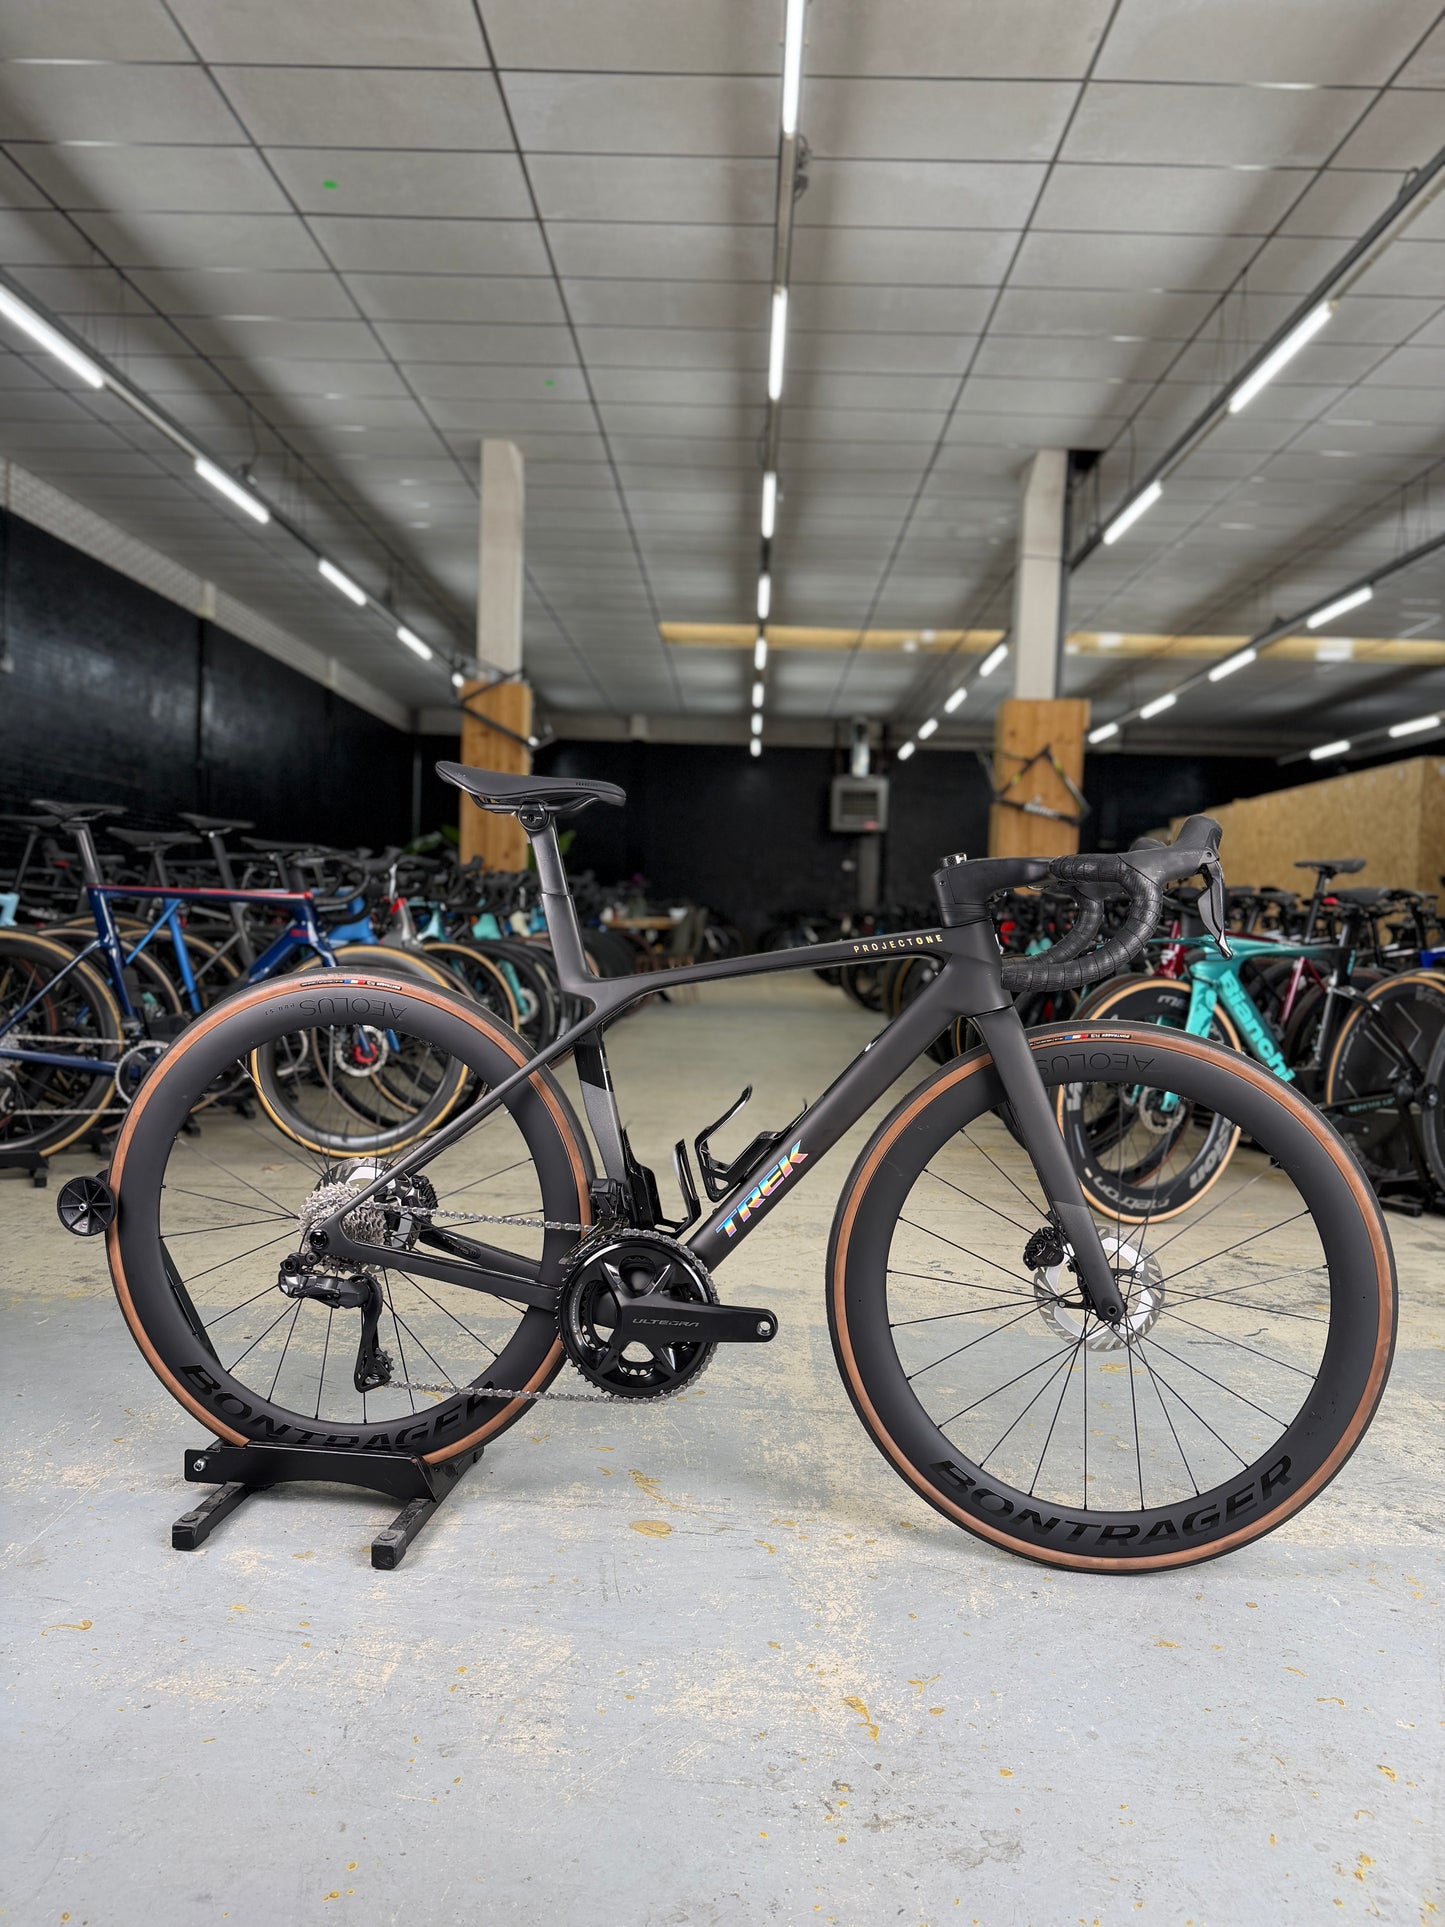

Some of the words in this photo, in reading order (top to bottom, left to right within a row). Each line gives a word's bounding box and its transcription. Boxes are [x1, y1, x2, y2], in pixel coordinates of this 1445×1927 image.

[300, 997, 408, 1020] AEOLUS
[1219, 970, 1296, 1082] Bianchi
[715, 1139, 809, 1238] TREK
[1188, 1117, 1232, 1190] ision
[632, 1317, 701, 1329] ULTEGRA
[929, 1454, 1293, 1546] BONTRAGER
